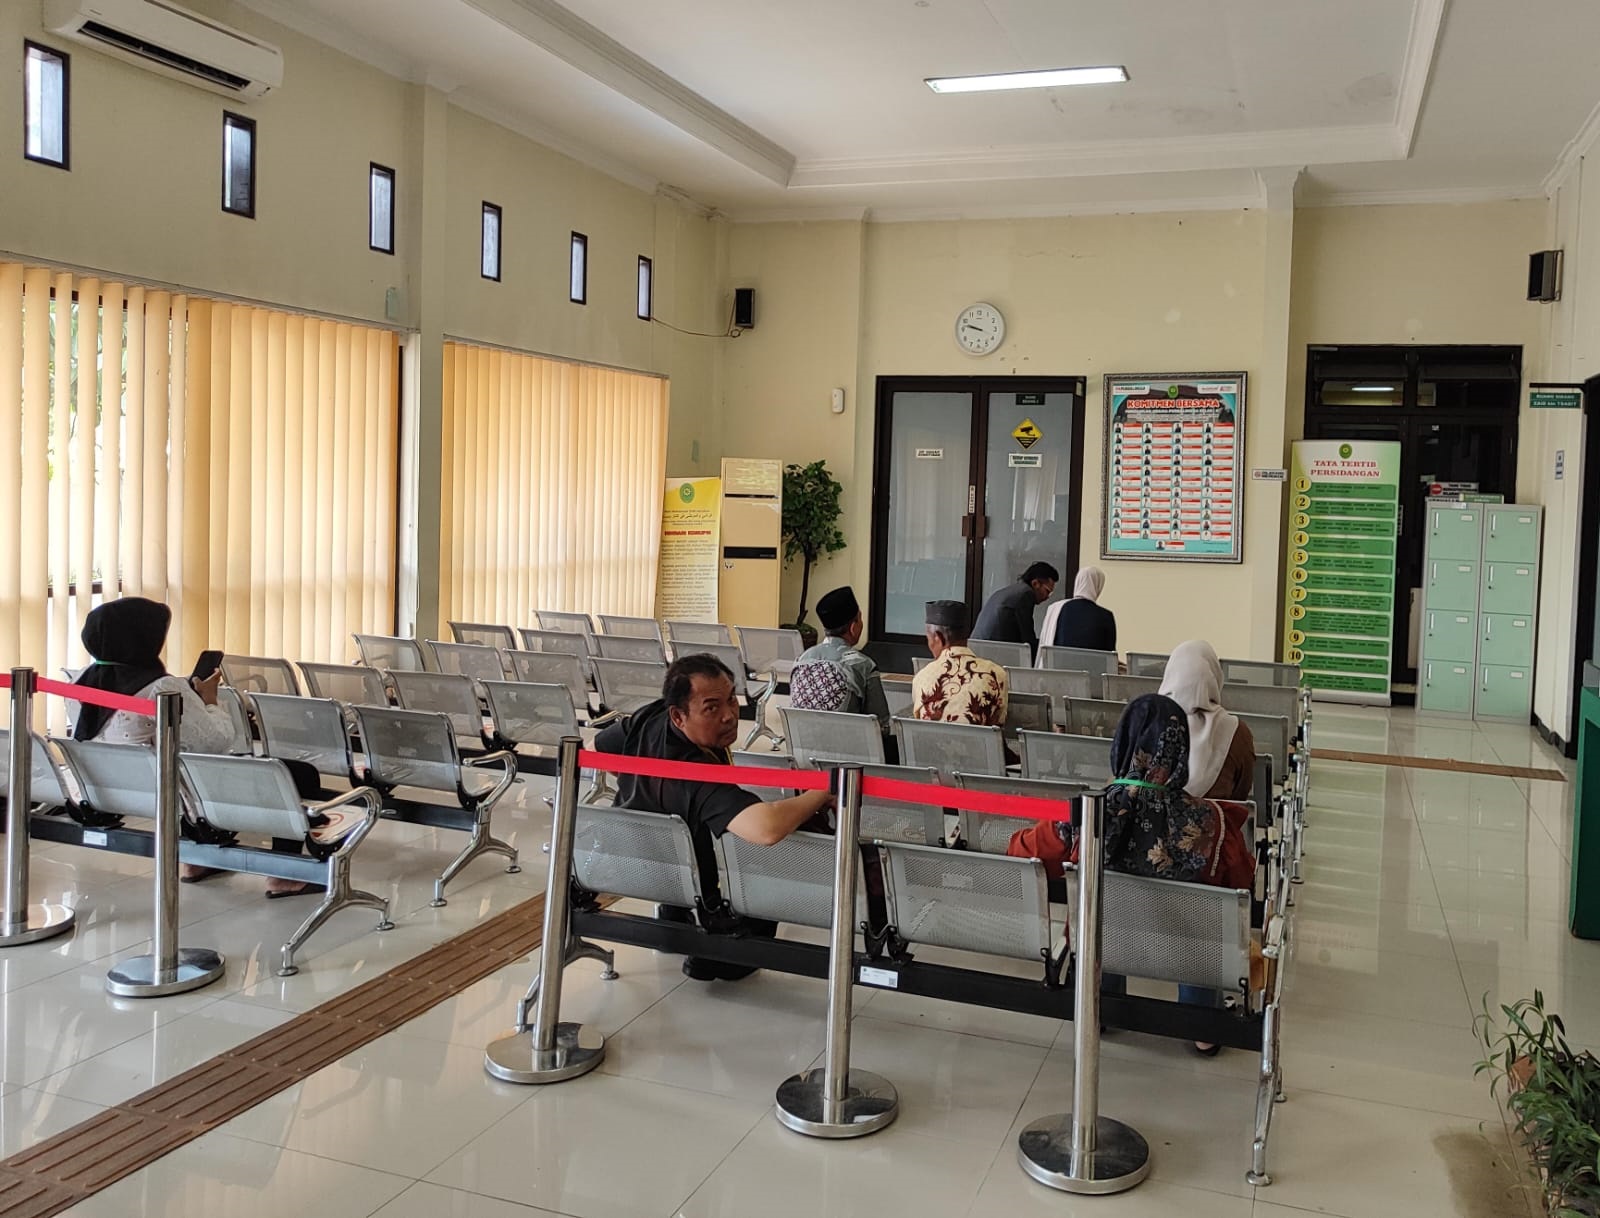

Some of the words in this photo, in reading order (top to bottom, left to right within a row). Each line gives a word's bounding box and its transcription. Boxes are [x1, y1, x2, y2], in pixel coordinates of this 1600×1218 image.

[1126, 400, 1175, 409] KOMITMEN
[1176, 400, 1220, 408] BERSAMA
[1310, 469, 1380, 477] PERSIDANGAN
[1300, 480, 1304, 488] 1
[1299, 498, 1305, 507] 2
[1300, 515, 1305, 524] 3
[1298, 534, 1303, 543] 4
[1297, 552, 1303, 560] 5
[1295, 588, 1301, 597] 7
[1294, 607, 1300, 616] 8
[1293, 633, 1299, 641] 9
[1290, 651, 1301, 660] 10
